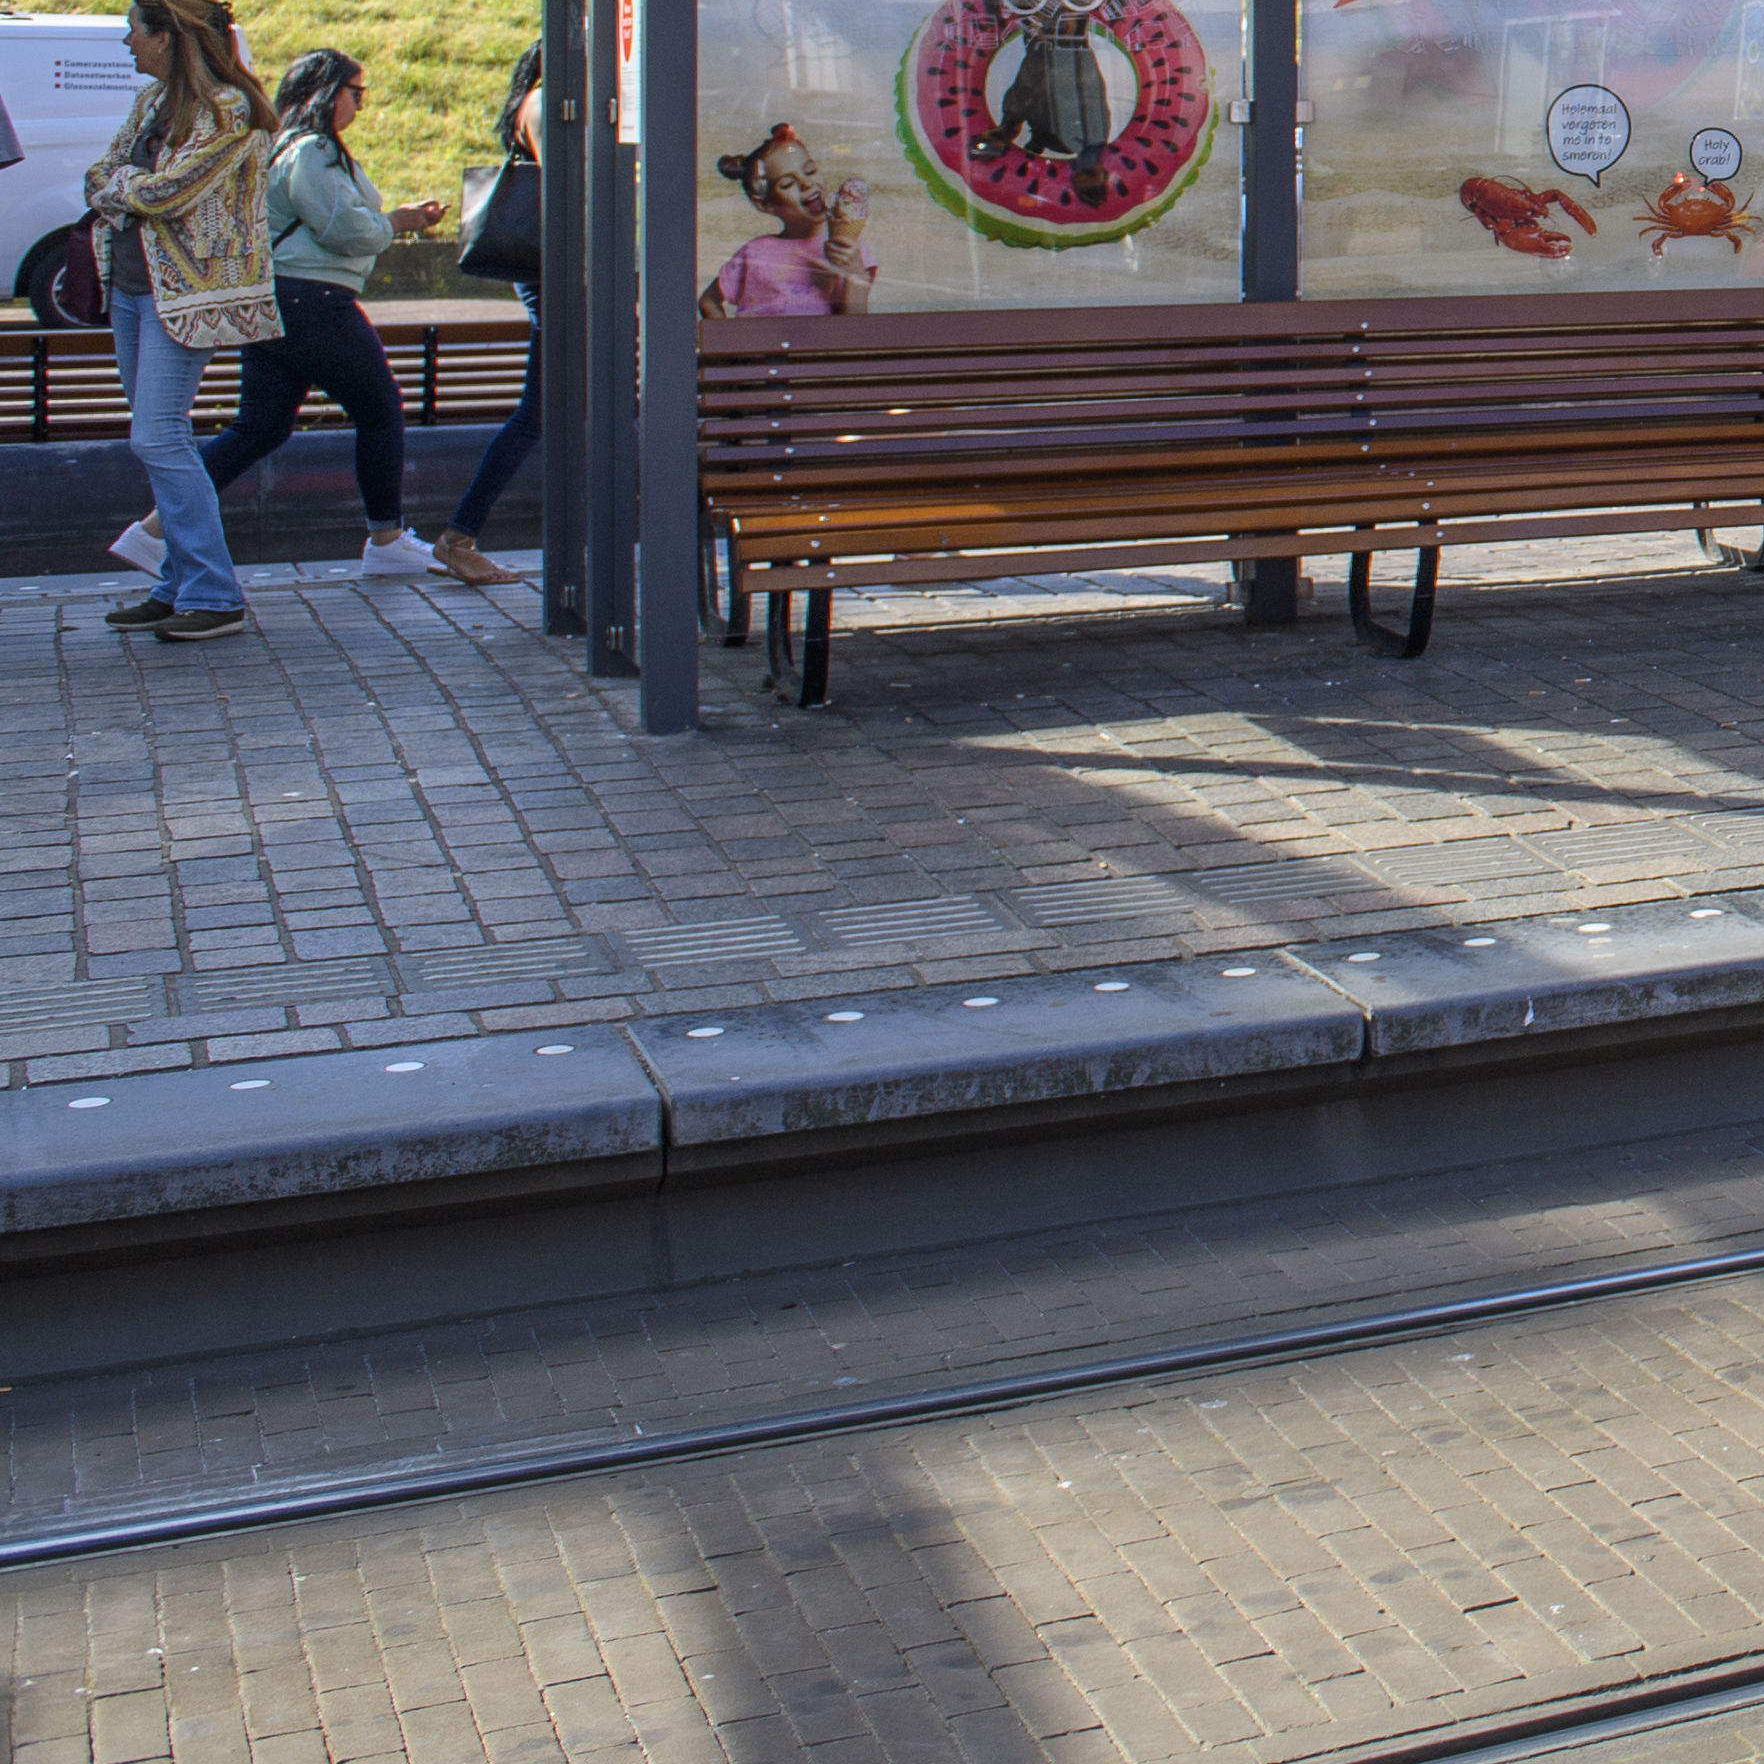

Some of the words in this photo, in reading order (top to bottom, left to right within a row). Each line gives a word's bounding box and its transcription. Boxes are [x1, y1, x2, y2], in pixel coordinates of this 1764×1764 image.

[1561, 103, 1617, 116] Helemaal
[1561, 120, 1617, 136] vergeten
[1563, 136, 1582, 146] me
[1584, 134, 1596, 145] in
[1598, 133, 1612, 145] te
[1704, 139, 1730, 154] Holy
[1561, 148, 1612, 161] smeren!
[1698, 153, 1731, 165] crab!
